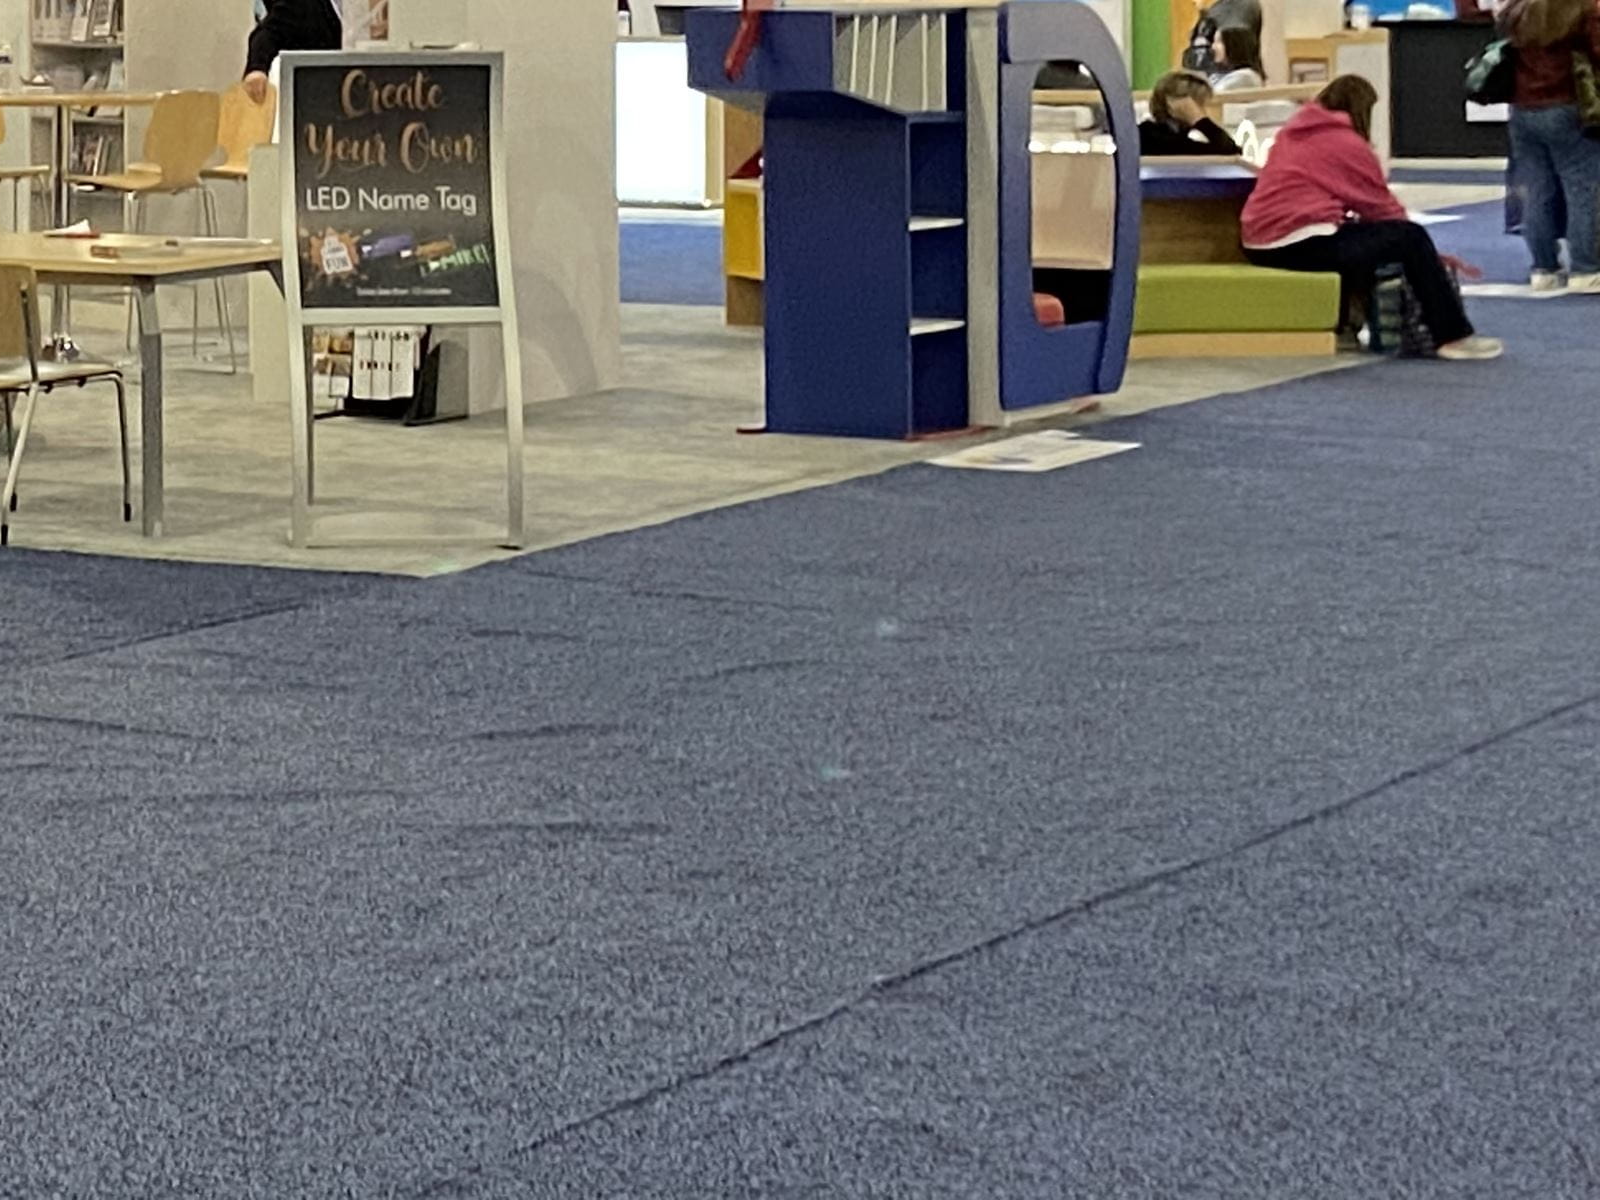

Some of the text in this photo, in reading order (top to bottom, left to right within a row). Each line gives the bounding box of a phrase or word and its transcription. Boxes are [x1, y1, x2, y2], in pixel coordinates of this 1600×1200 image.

[340, 68, 444, 121] Create
[305, 120, 479, 180] Your Own
[306, 186, 478, 217] LED Name Tag
